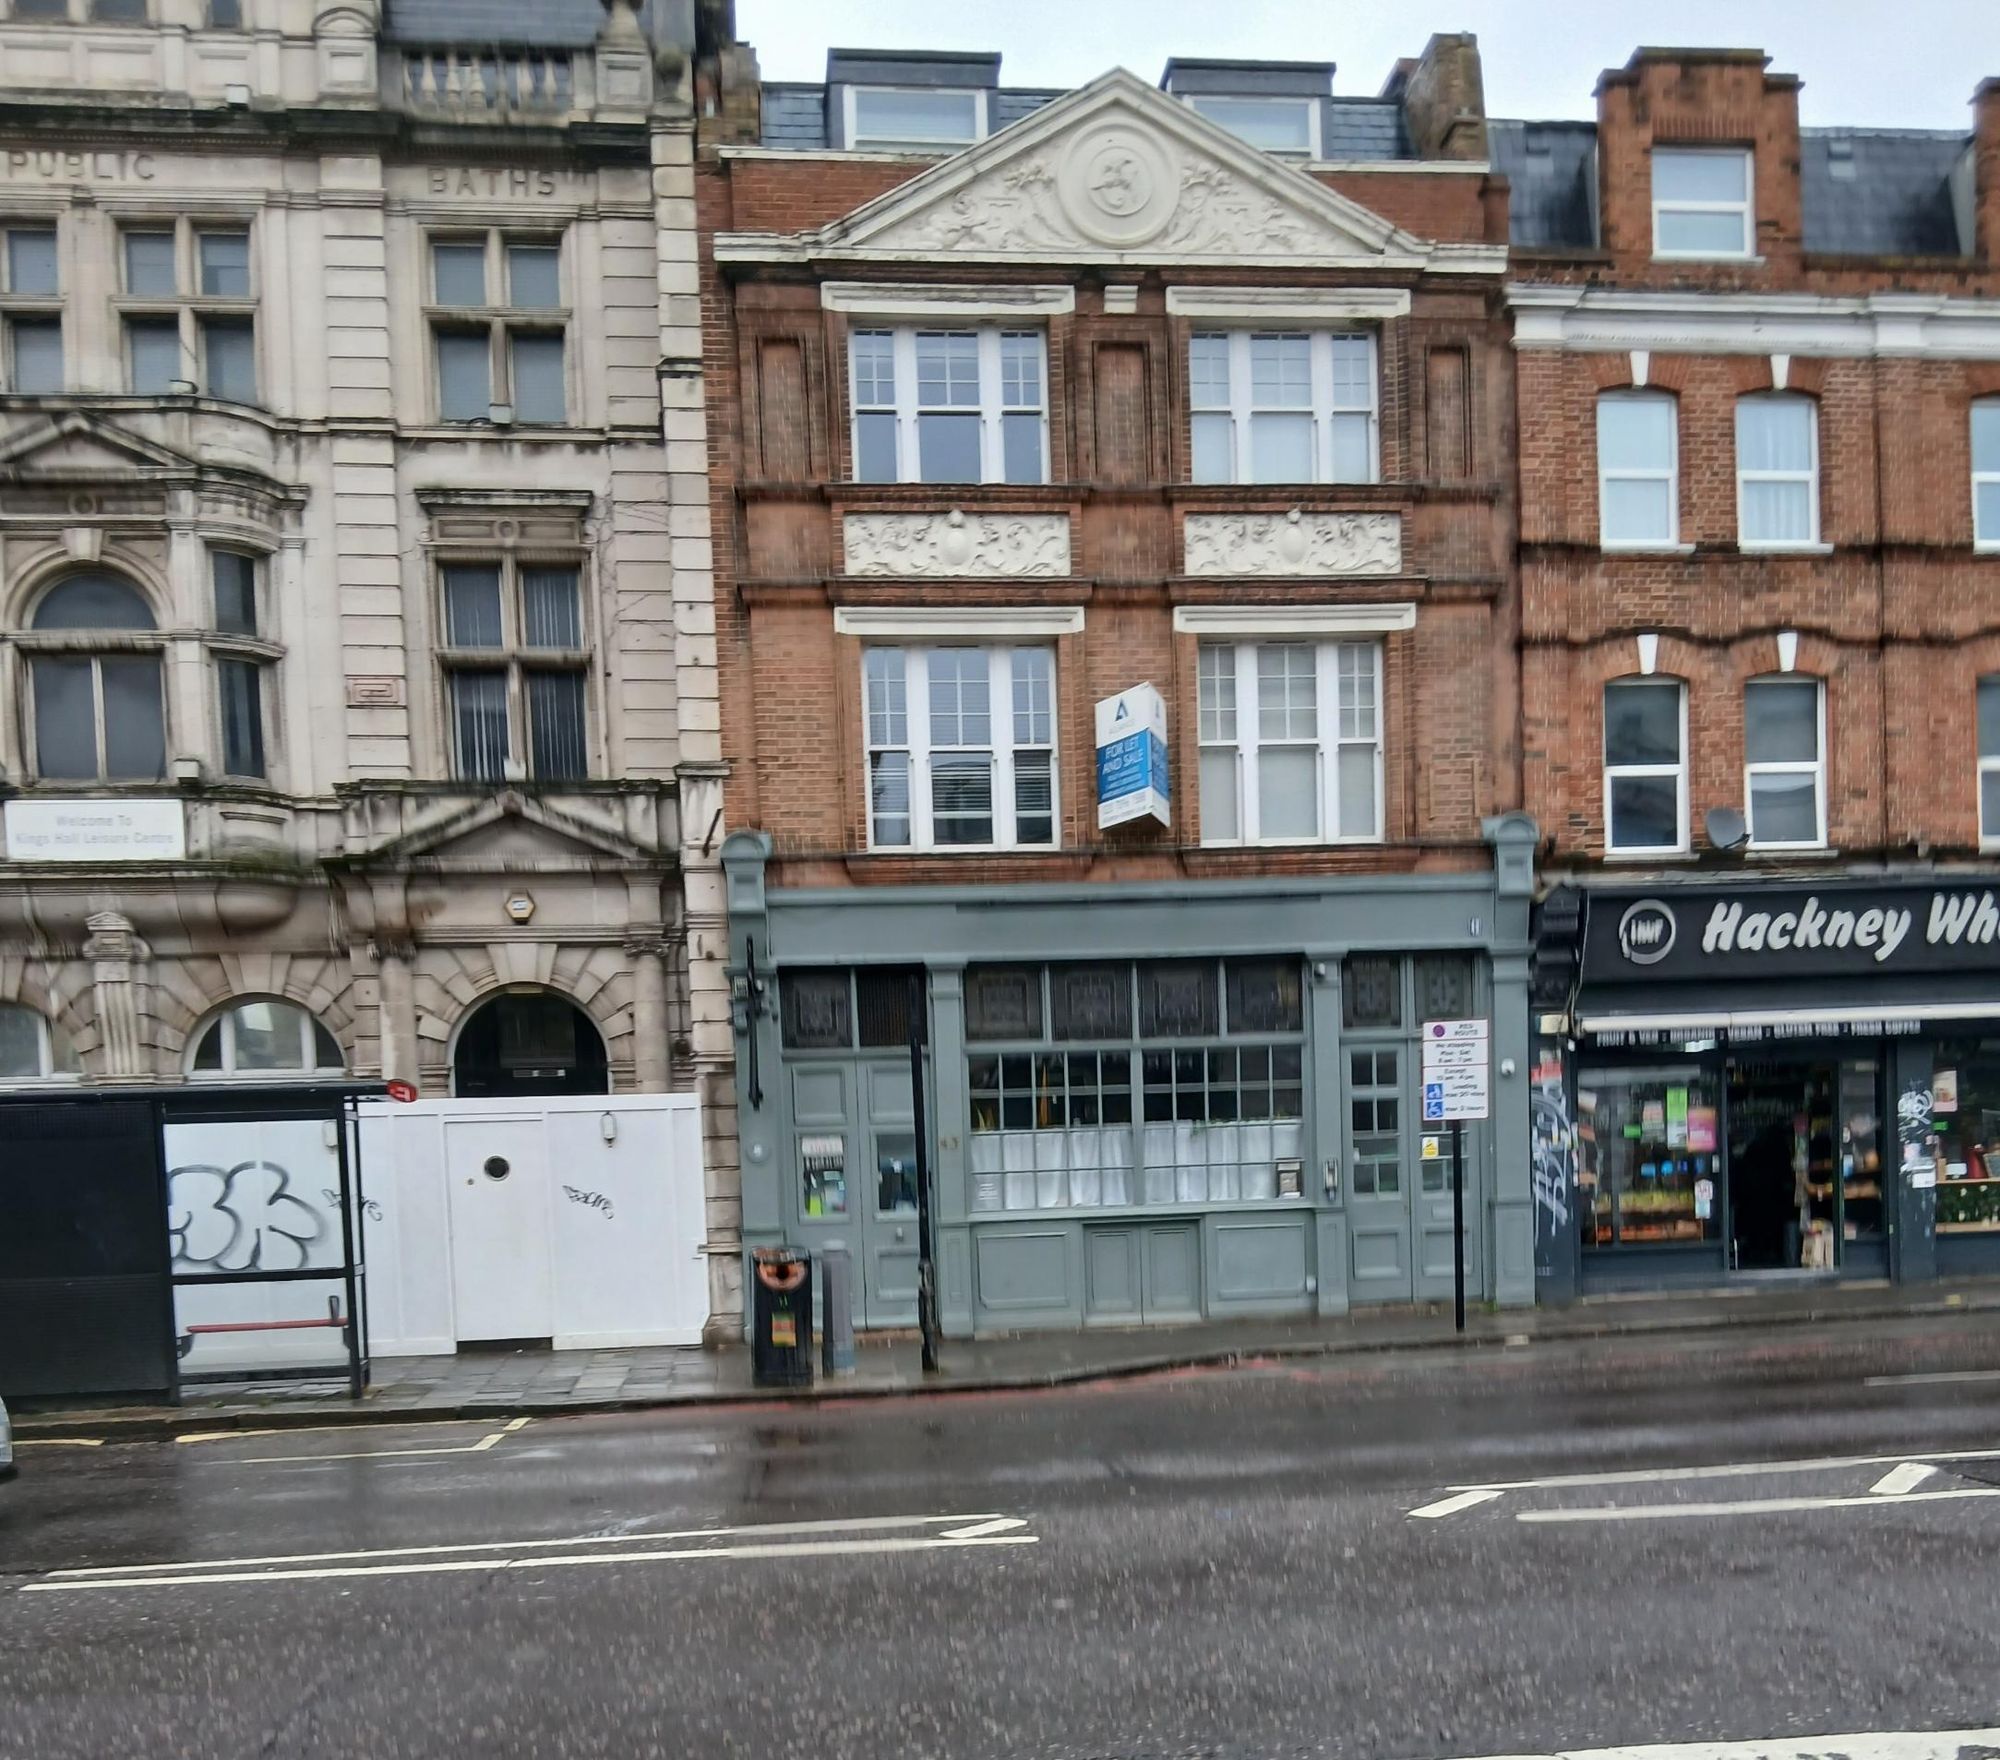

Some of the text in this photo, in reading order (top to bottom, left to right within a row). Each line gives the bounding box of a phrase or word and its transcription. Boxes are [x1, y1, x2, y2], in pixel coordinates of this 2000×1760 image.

[7, 150, 155, 180] PUBLIC
[427, 167, 555, 197] BATHS
[56, 814, 132, 827] Welcome To
[54, 832, 79, 844] Hall
[83, 831, 129, 844] Leisure
[133, 832, 174, 844] Centre
[1702, 890, 2000, 962] Hackney Wh
